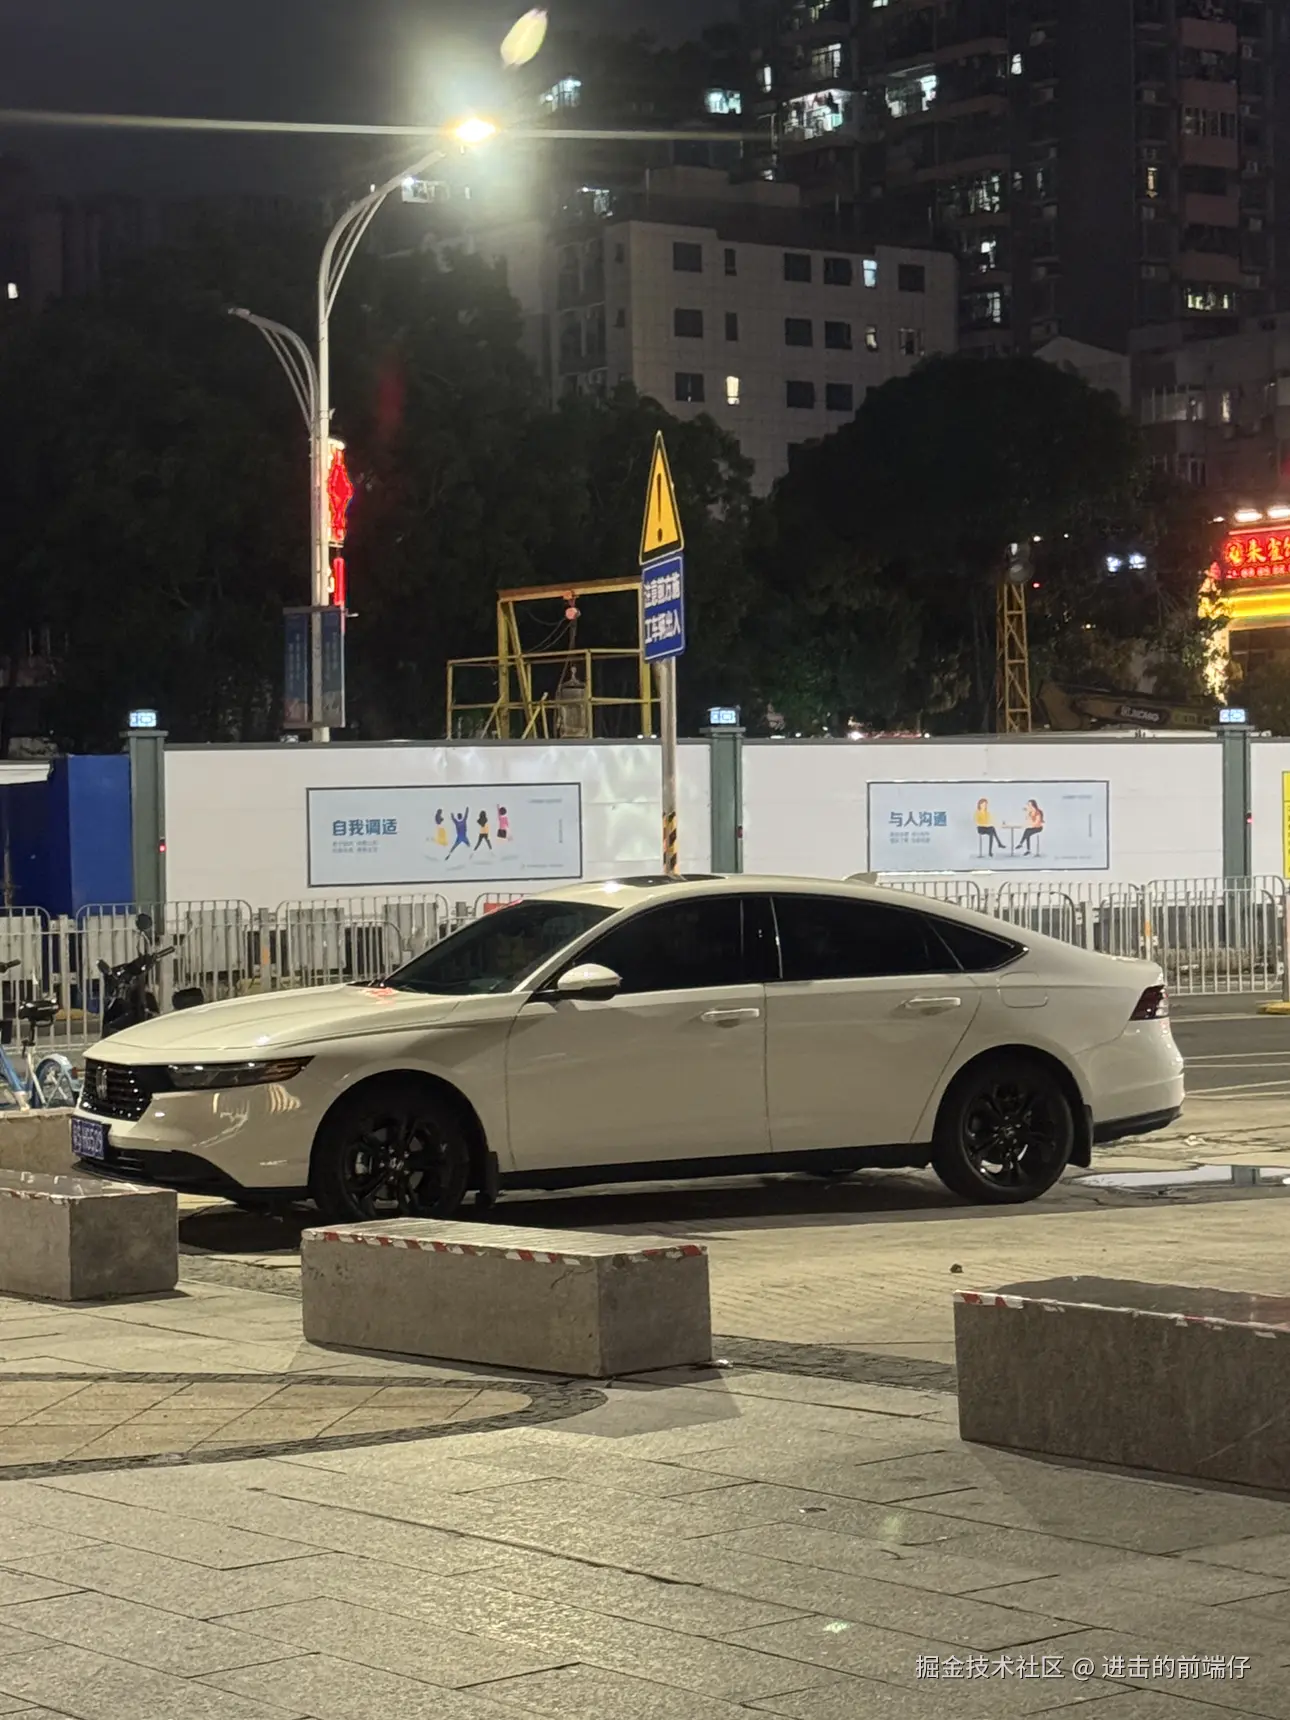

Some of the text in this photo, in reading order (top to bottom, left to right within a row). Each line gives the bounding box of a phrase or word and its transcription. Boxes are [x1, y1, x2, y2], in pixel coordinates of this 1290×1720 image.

[332, 818, 398, 837] 自我调适
[888, 810, 948, 828] 与人沟通
